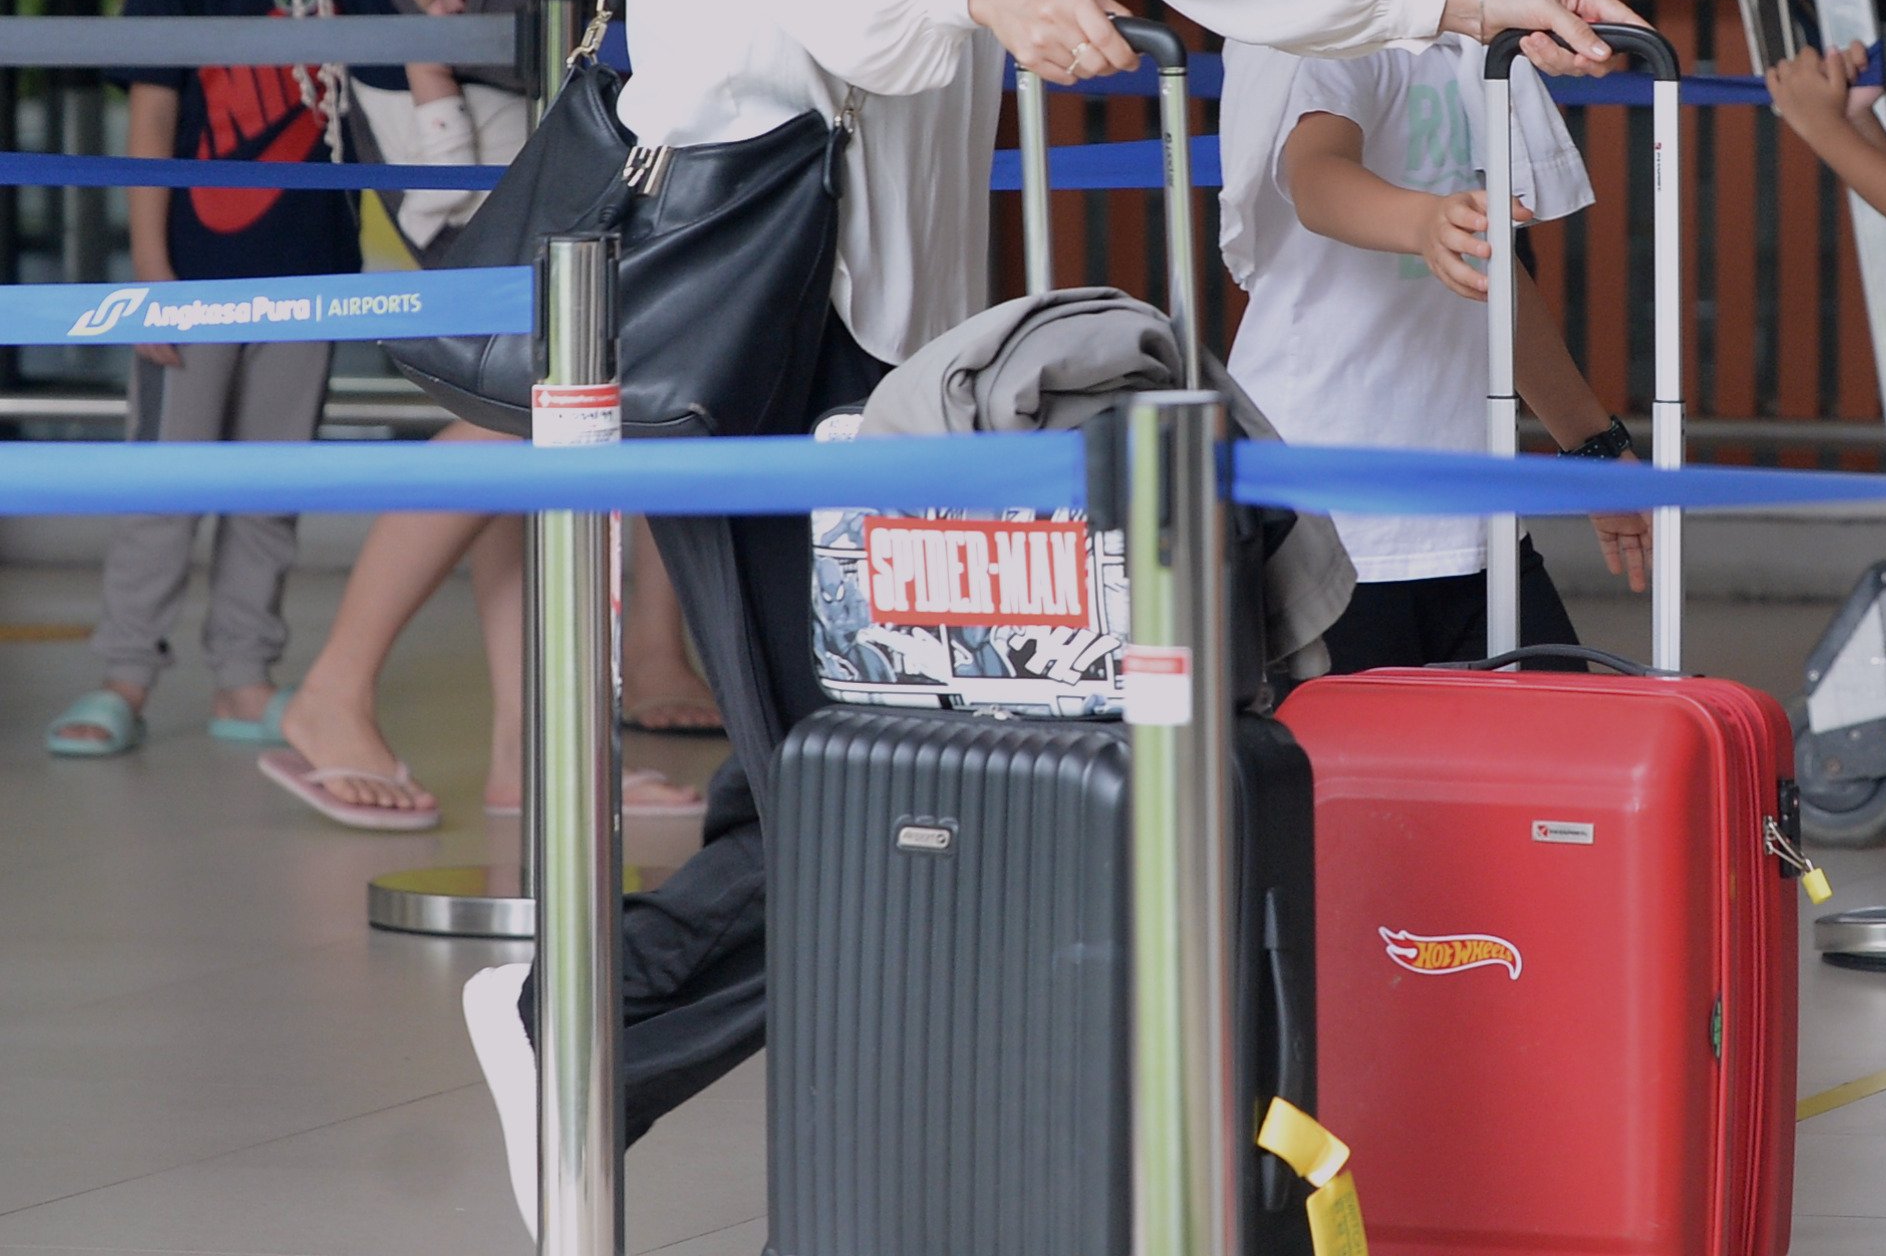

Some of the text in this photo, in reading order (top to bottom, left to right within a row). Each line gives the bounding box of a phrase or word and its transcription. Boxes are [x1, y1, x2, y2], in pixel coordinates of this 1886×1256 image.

[198, 63, 326, 158] NI
[327, 293, 422, 317] AIRPORTS
[869, 527, 1082, 616] SPIDER-MAN
